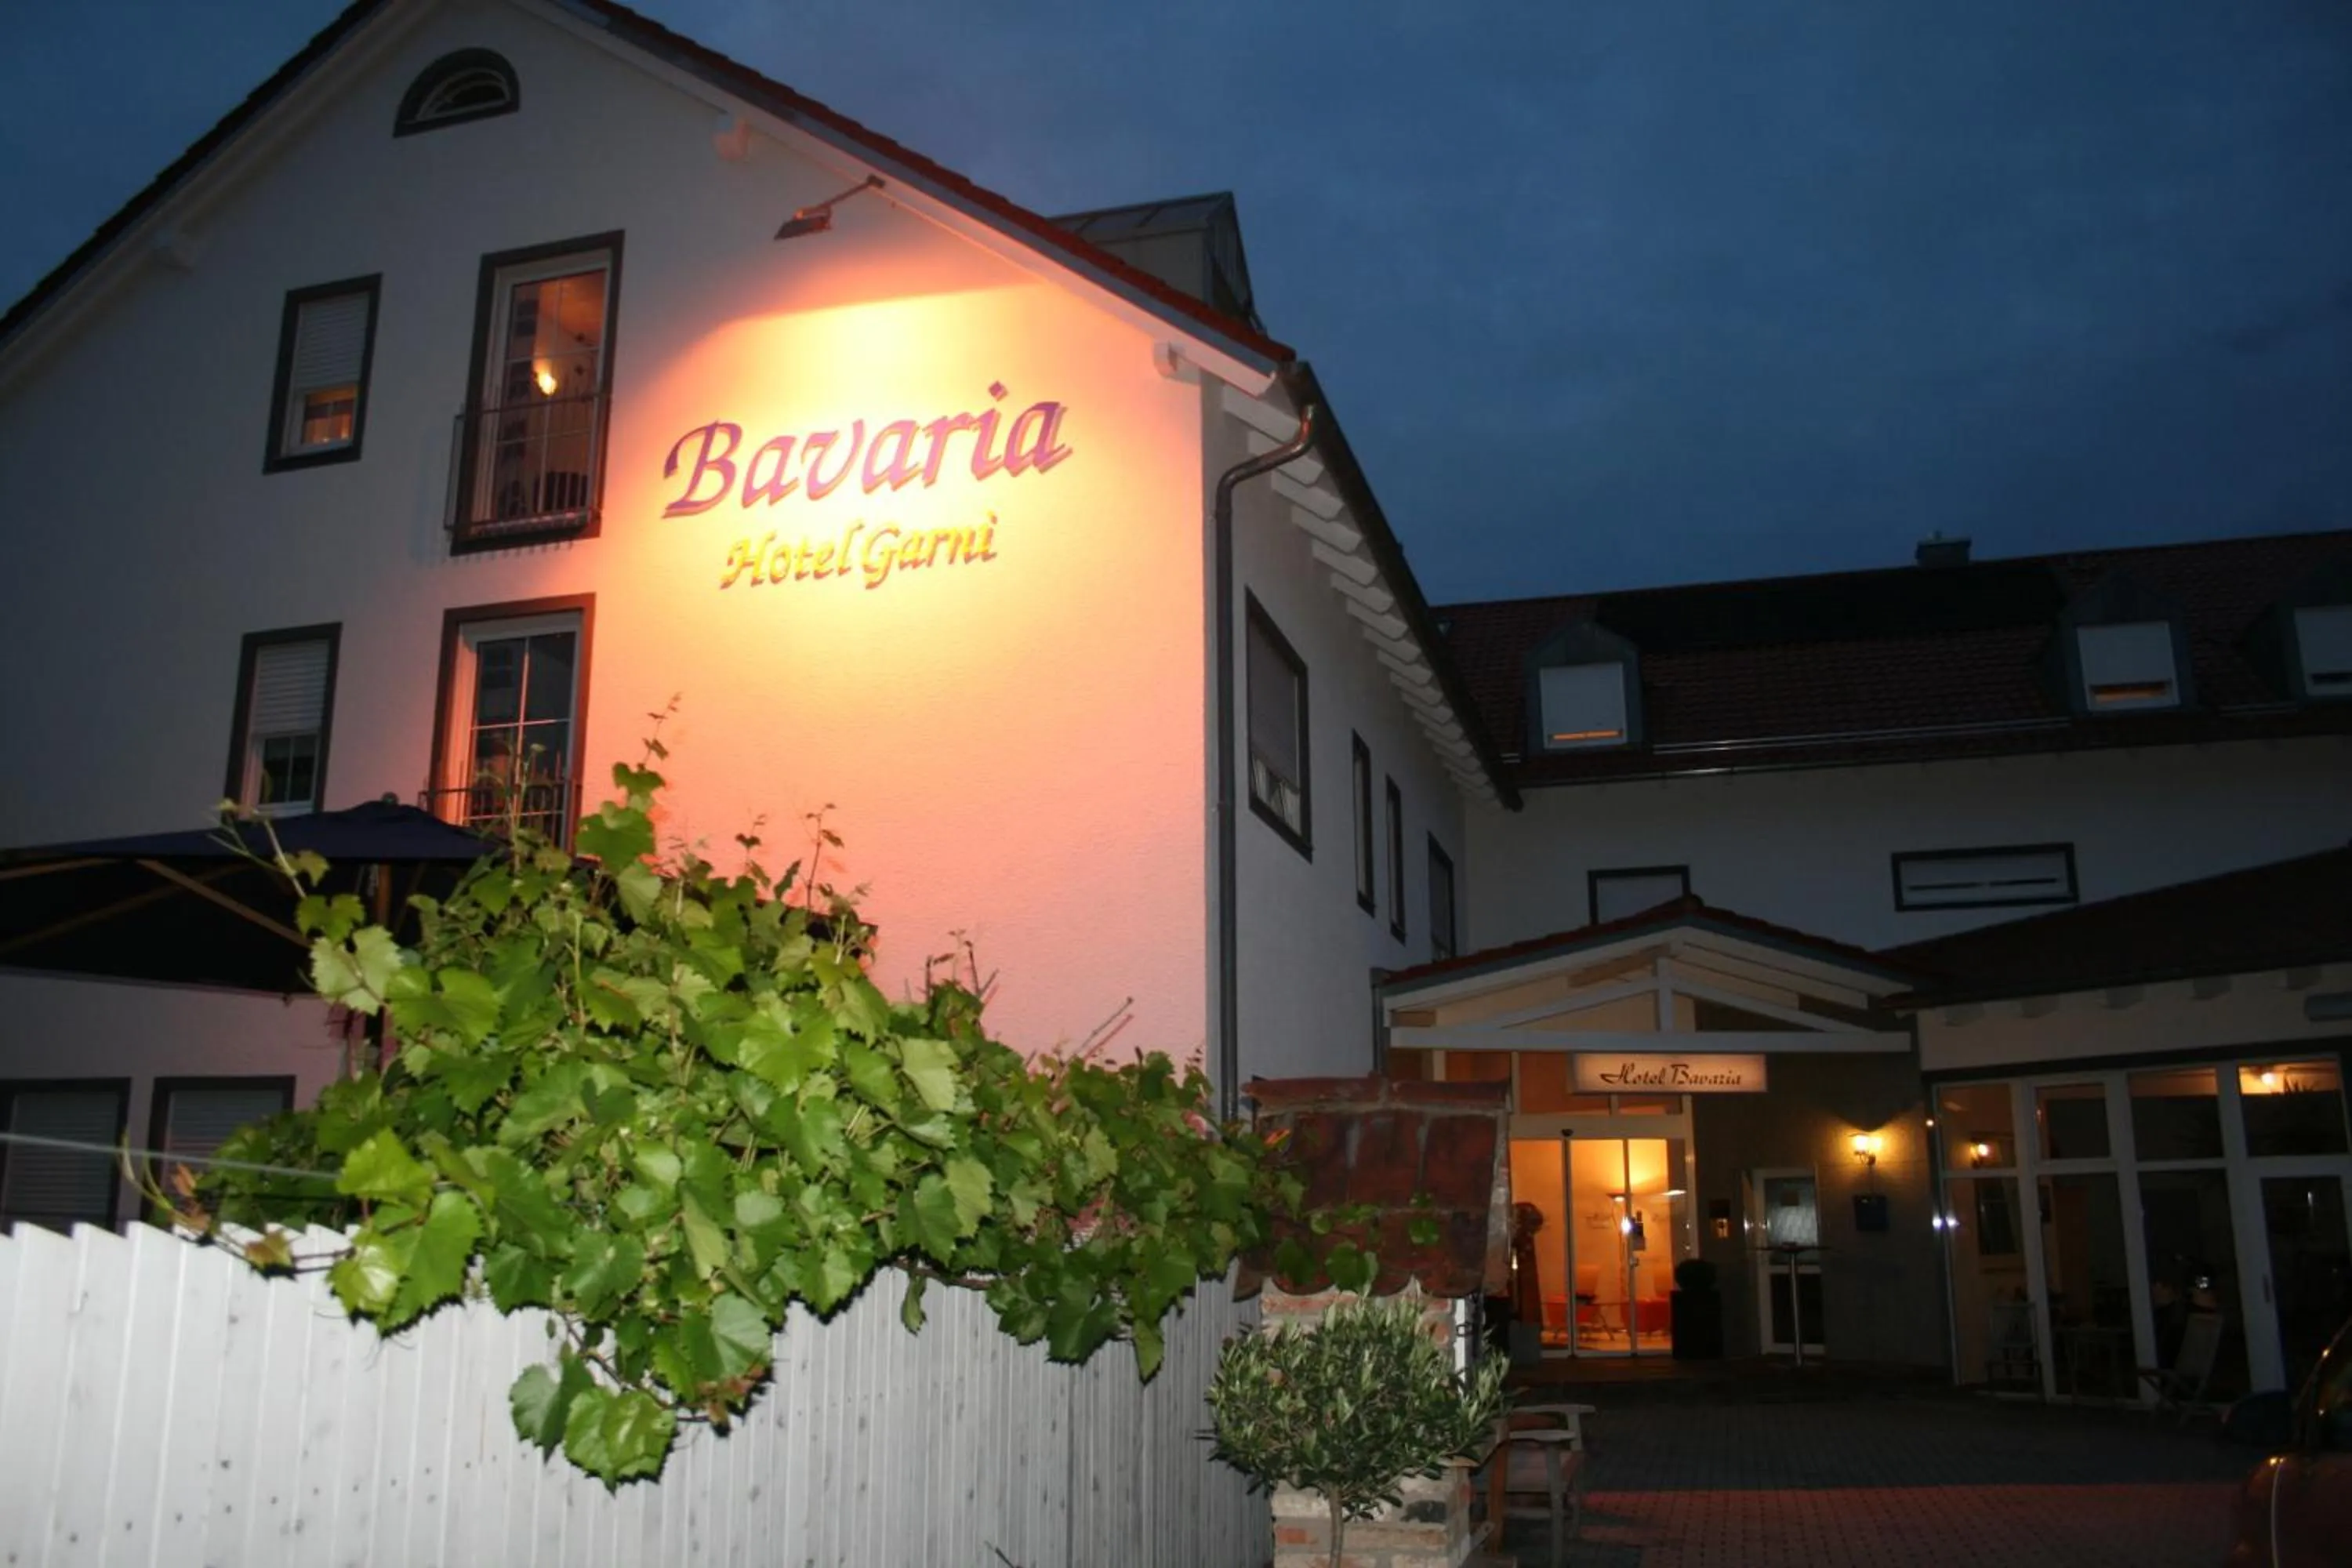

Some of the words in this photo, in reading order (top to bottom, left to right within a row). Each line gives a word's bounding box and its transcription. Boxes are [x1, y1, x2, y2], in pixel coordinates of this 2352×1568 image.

[661, 380, 1073, 519] Bavaria
[720, 523, 864, 590] Hotel
[861, 510, 998, 590] Garni
[1599, 1062, 1665, 1085] Hotel
[1671, 1063, 1741, 1085] Bavaria
